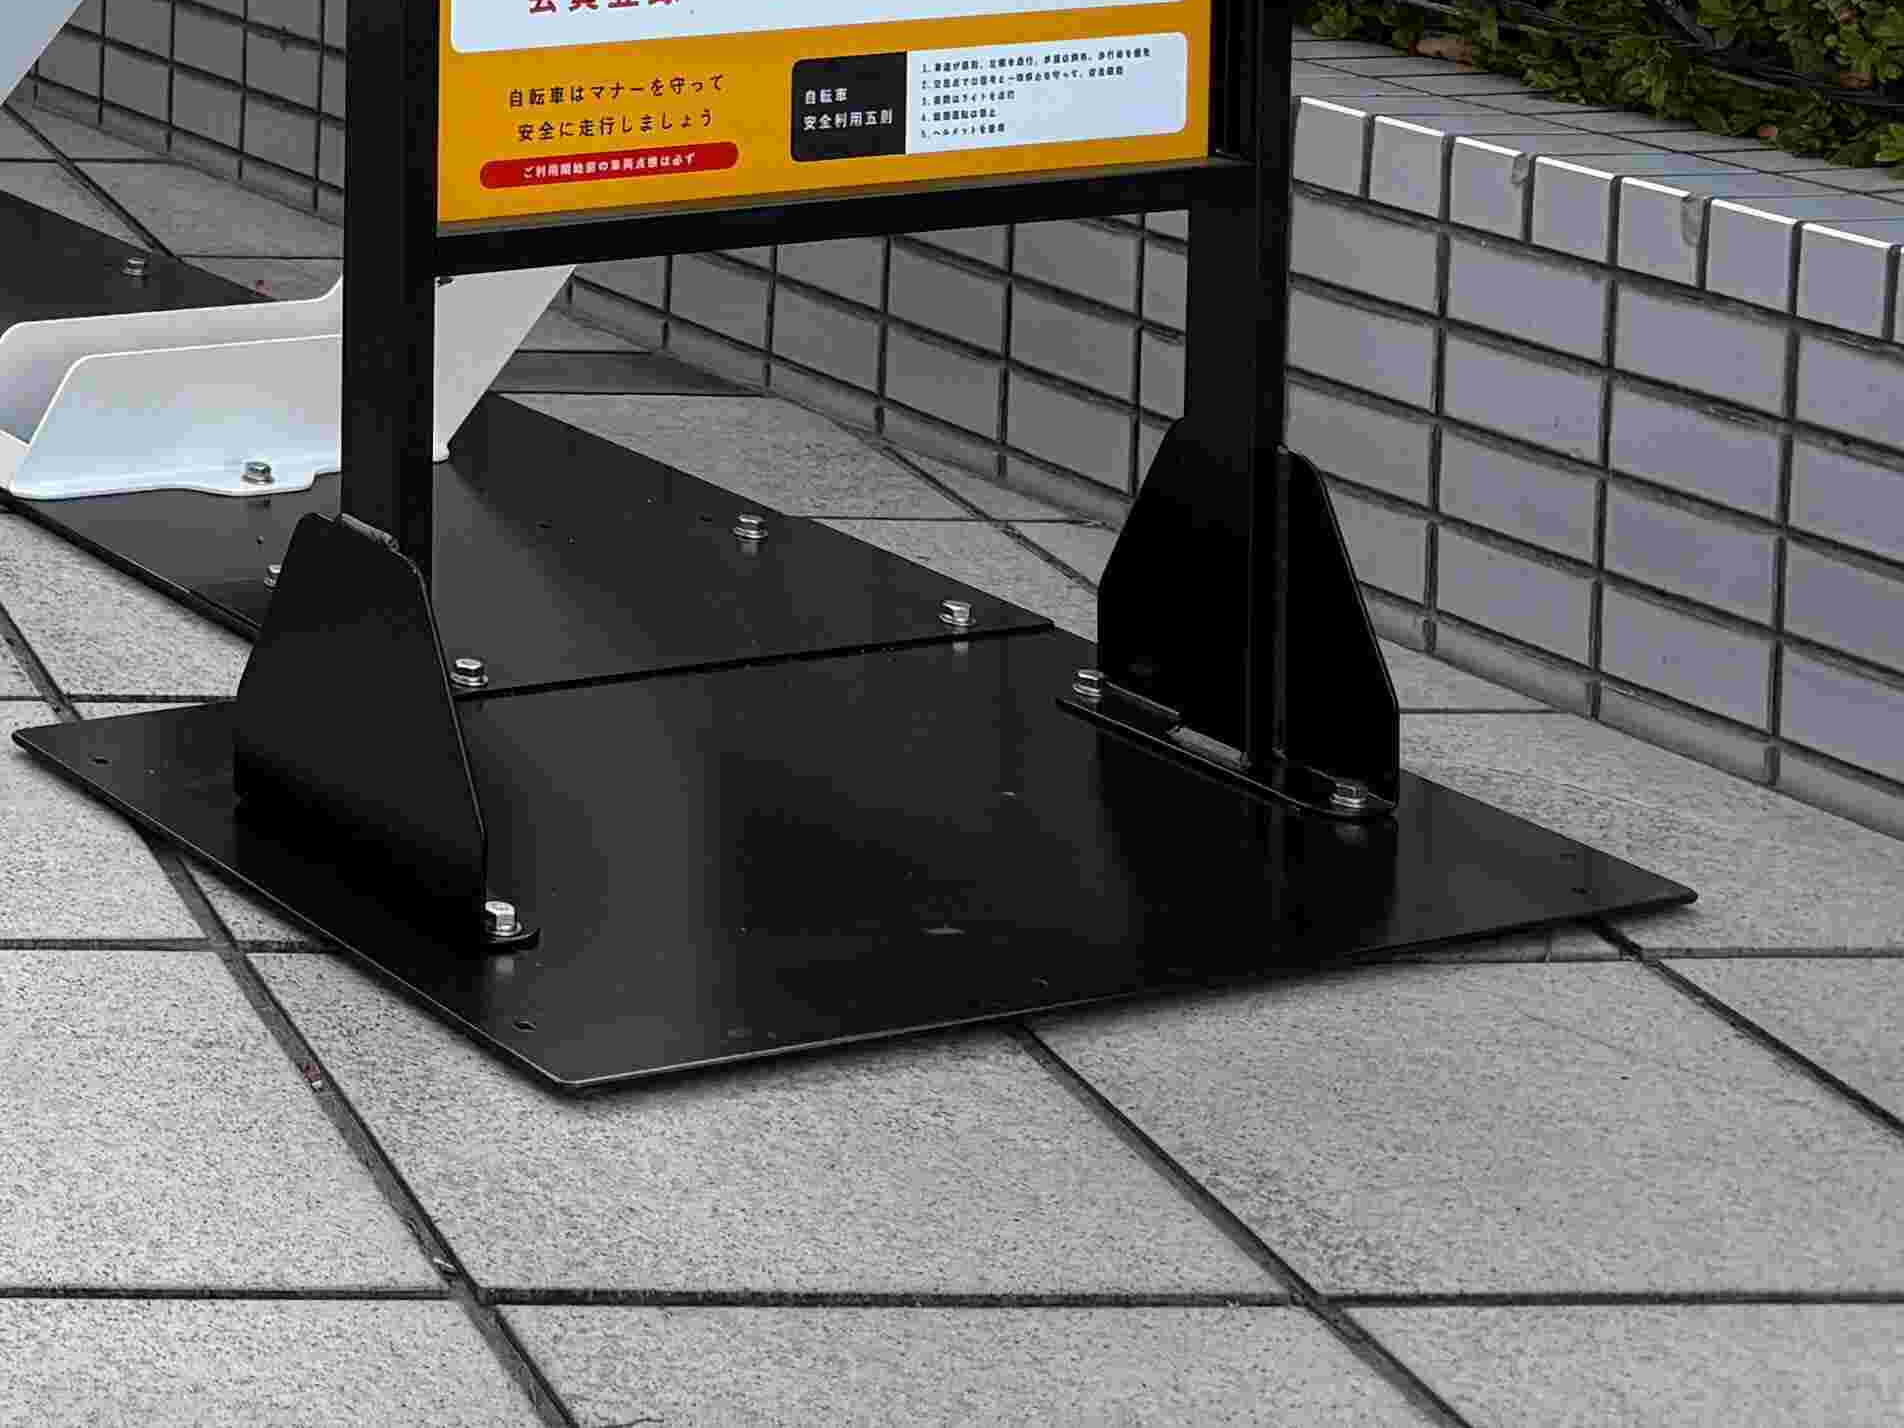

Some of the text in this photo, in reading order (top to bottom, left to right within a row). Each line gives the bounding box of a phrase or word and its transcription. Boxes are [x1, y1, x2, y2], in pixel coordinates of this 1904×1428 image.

[509, 73, 725, 109] 自転車はマナーを守って
[804, 87, 849, 105] 自転車
[517, 108, 713, 142] 安全に走行しましょう
